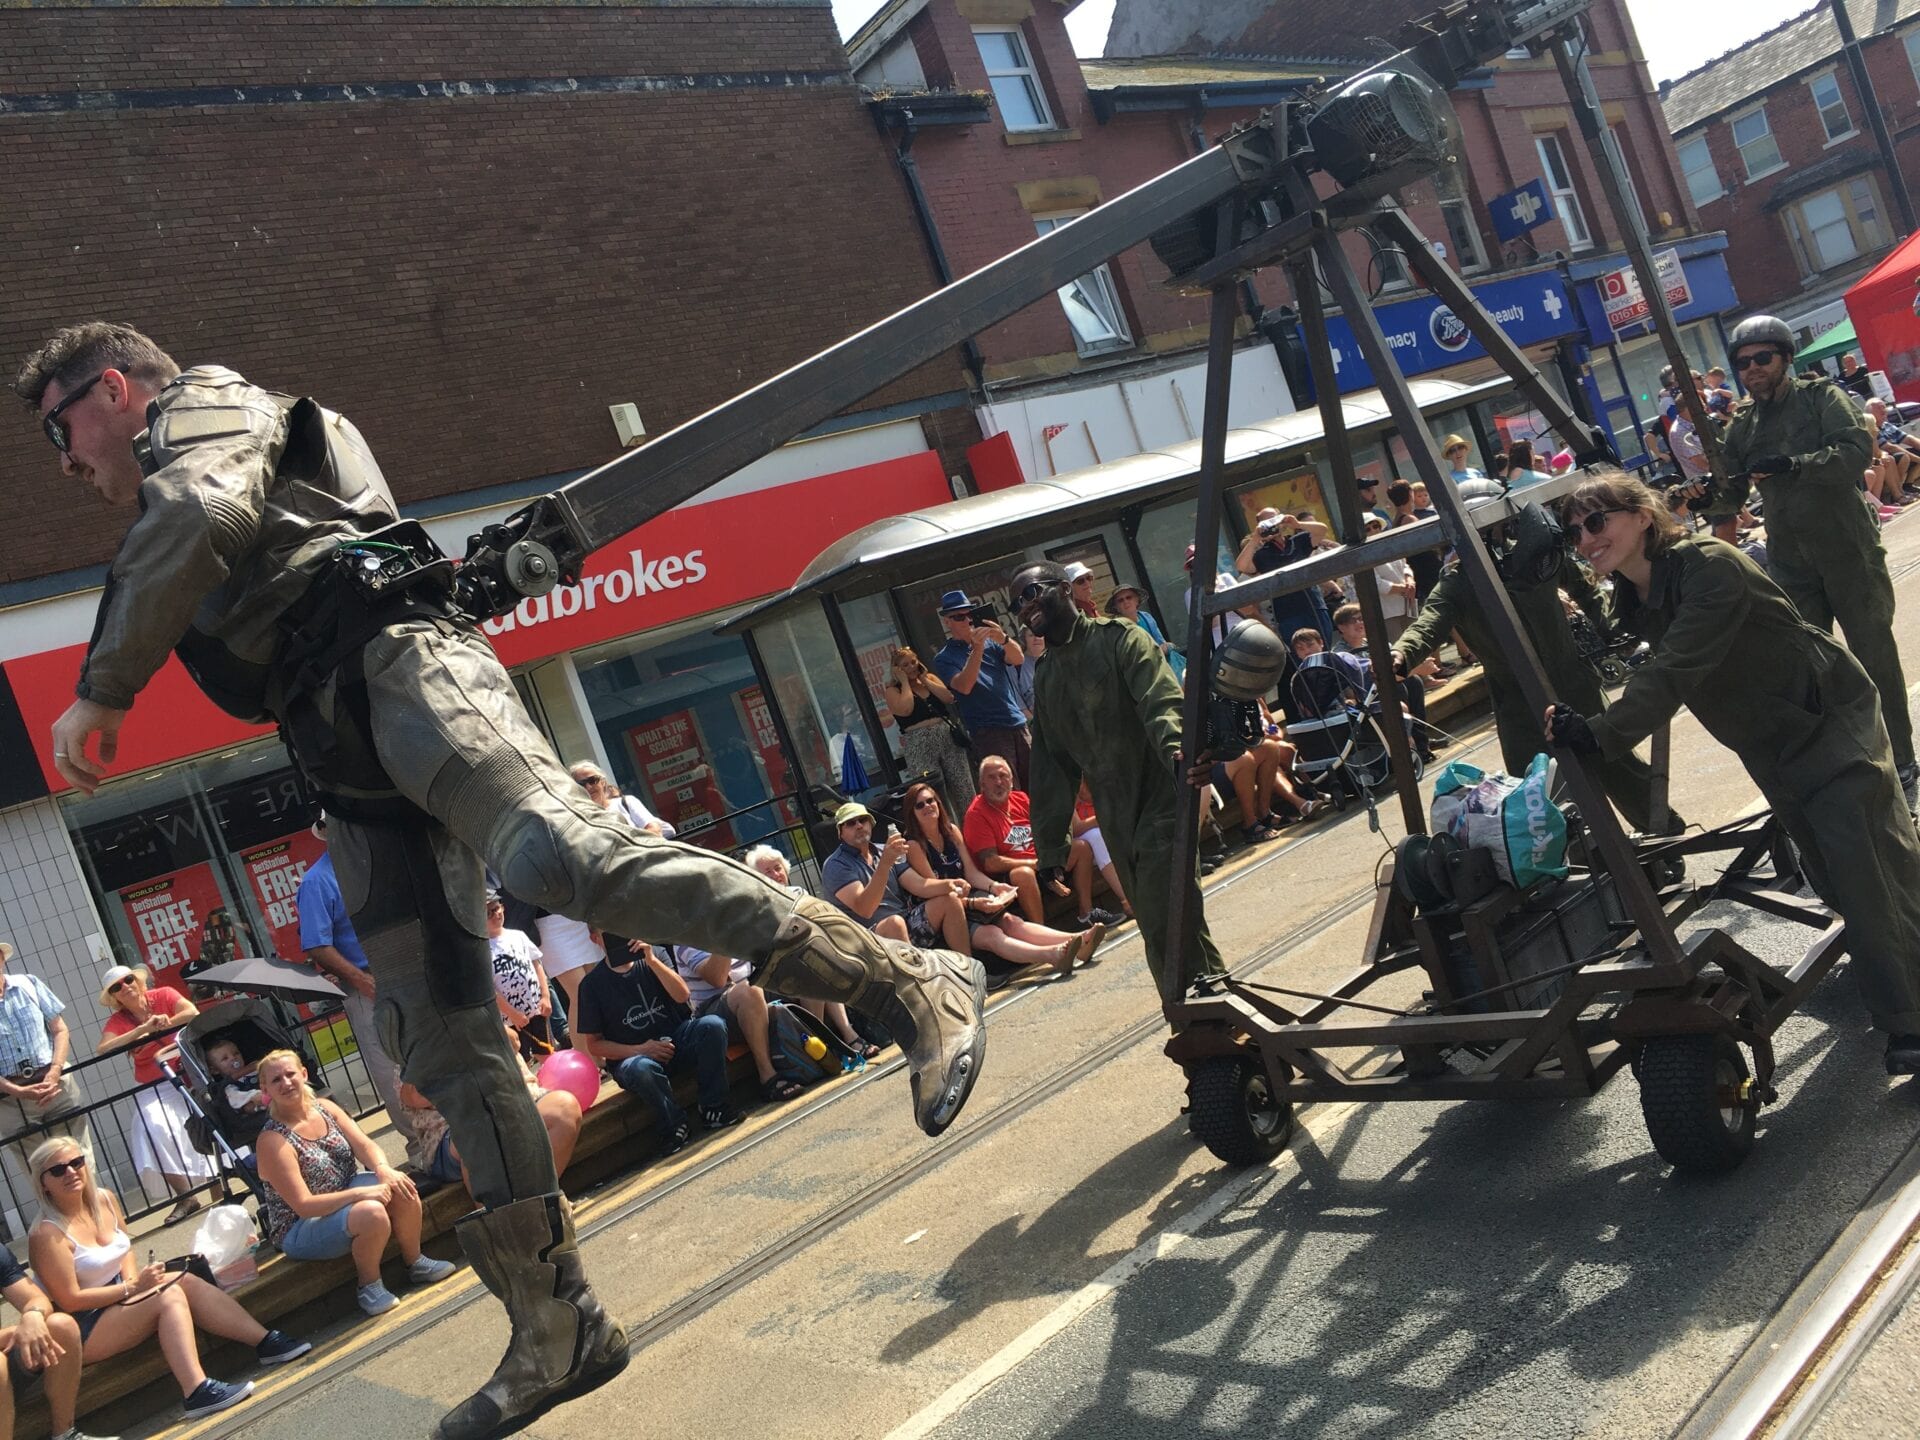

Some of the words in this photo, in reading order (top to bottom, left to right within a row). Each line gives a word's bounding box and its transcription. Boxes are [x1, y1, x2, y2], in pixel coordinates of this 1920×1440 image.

[635, 723, 670, 747] WHAT'S
[671, 718, 689, 736] THE
[649, 734, 684, 756] SCORE?
[248, 846, 272, 861] WORLD
[273, 843, 287, 855] CUP
[252, 854, 289, 873] BetStation
[128, 885, 154, 900] WORLD
[154, 881, 169, 894] CUP
[131, 892, 172, 913] BetStation
[136, 898, 199, 944] FREE
[146, 934, 191, 971] BET
